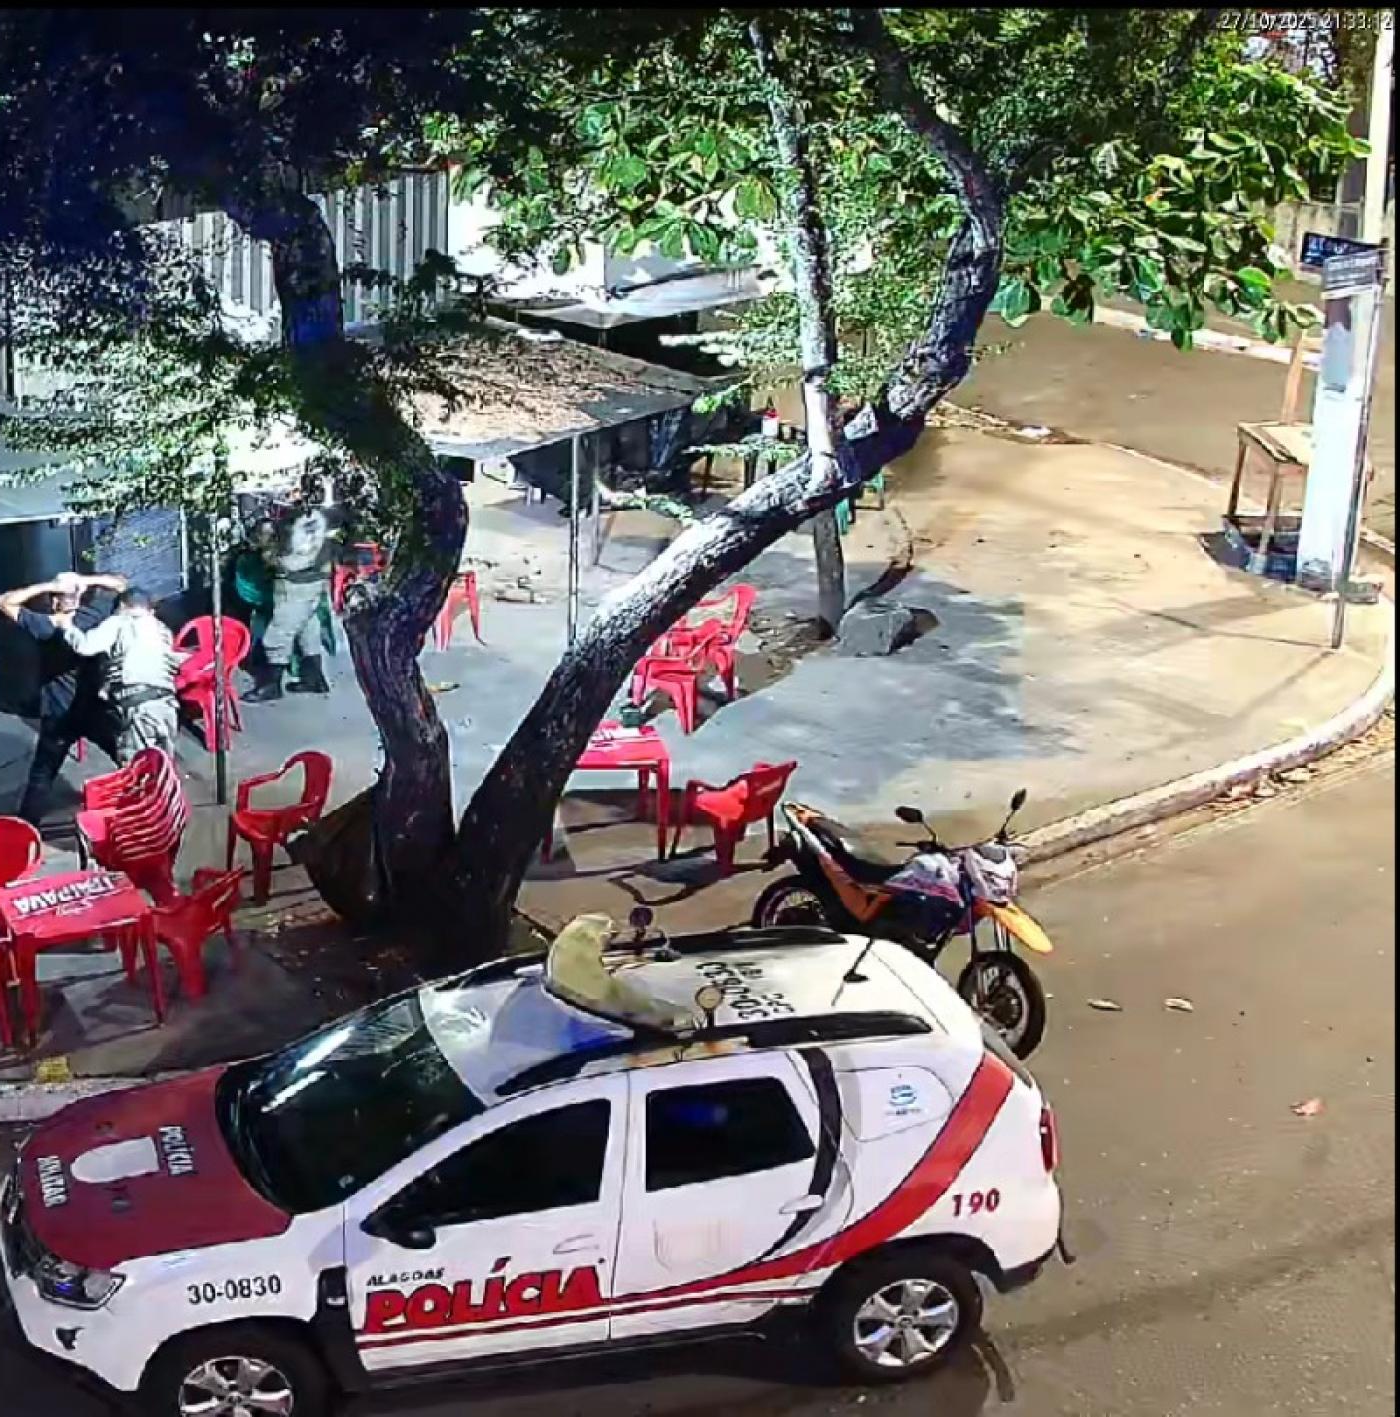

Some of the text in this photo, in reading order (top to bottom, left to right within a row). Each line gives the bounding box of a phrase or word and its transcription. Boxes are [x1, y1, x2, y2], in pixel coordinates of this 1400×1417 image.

[953, 1187, 1000, 1217] 190
[186, 1273, 282, 1305] 30-0830
[366, 1266, 445, 1287] ALAGOAS
[363, 1257, 604, 1334] POLÍCIA
